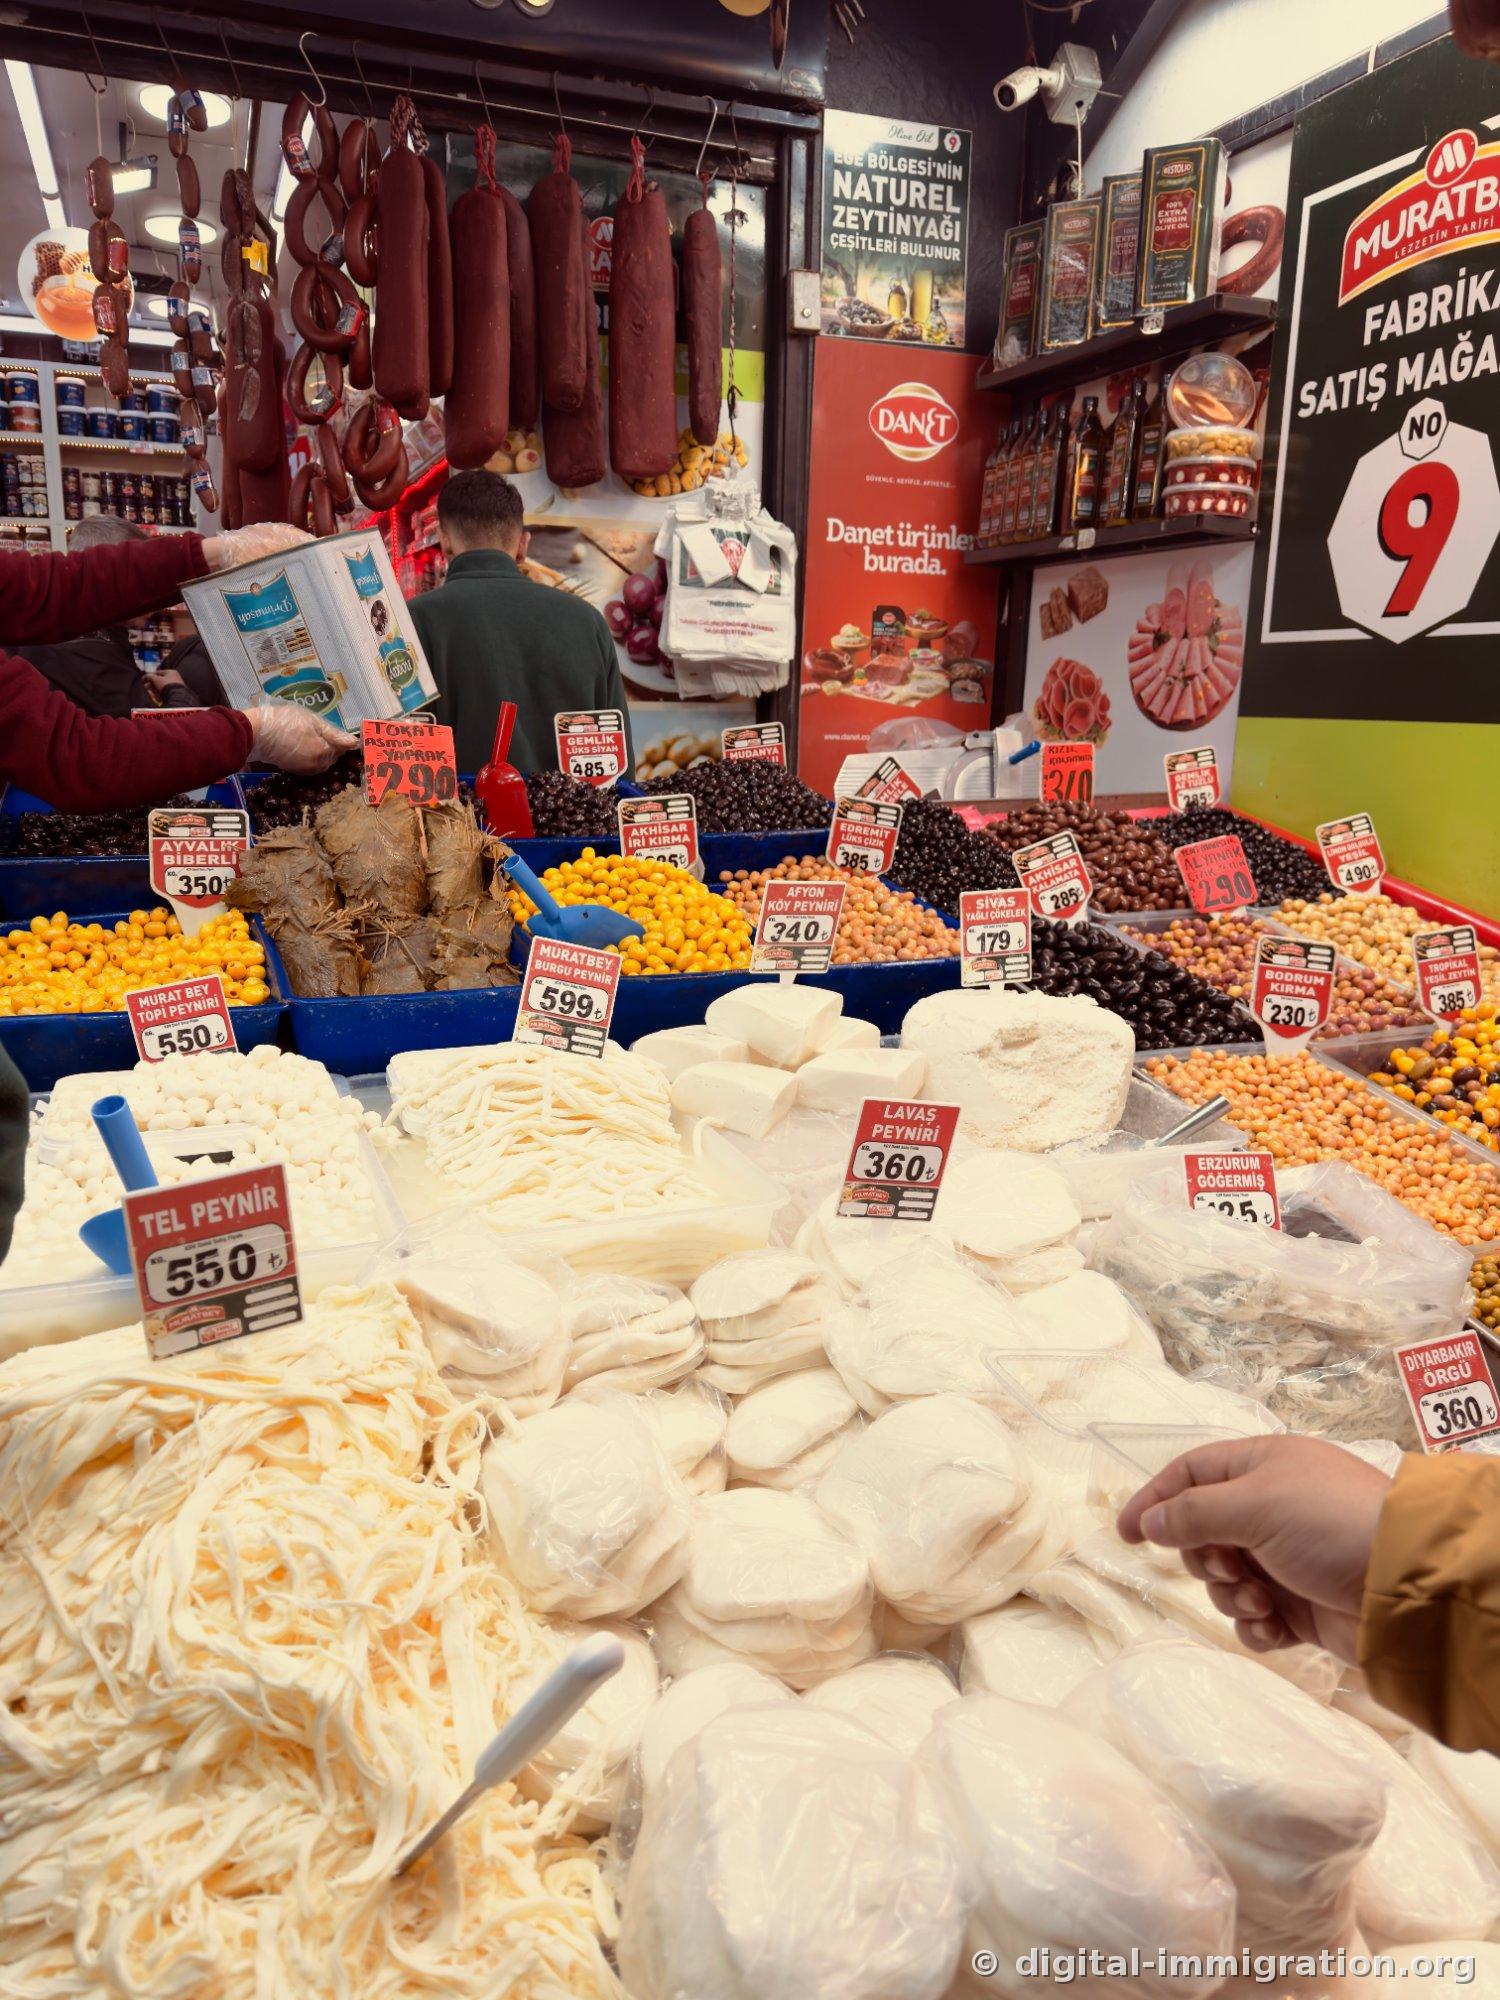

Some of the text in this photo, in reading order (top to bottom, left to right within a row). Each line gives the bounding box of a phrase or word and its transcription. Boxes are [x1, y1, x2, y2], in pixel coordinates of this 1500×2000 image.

[916, 129, 935, 144] Oil
[867, 151, 963, 182] BÖLGESİ'NİN
[832, 169, 961, 214] NATUREL
[832, 205, 961, 243] ZEYTİNYAĞI
[1158, 207, 1188, 218] EXTRA
[1158, 216, 1187, 225] VIRGIN
[1353, 176, 1500, 271] MURATB
[830, 232, 961, 262] ÇEŞİTLERİ BULUNUR
[1394, 216, 1494, 260] LEZZETİN TARİFİ
[1297, 329, 1500, 419] SATIŞ MAĞA
[878, 407, 952, 447] DANET
[1408, 411, 1442, 442] NO
[826, 517, 896, 549] Danet
[1377, 461, 1460, 618] 9
[863, 545, 948, 576] burada.
[367, 721, 440, 738] TOKAT
[567, 734, 616, 746] GEMLİK
[382, 749, 447, 764] YAPRAK
[566, 744, 619, 755] LÜKS SİYAH
[729, 746, 780, 760] MUDANYA
[573, 761, 605, 778] 485
[628, 834, 691, 848] İRİ KIRMA
[630, 822, 688, 837] AKHİSAR
[839, 822, 892, 840] EDREMİT
[841, 833, 886, 848] LÜKS ÇİZİK
[160, 840, 240, 852] AYVALIK
[163, 851, 237, 865] BİBERLİ
[840, 851, 869, 871] 385
[1028, 857, 1079, 886] AKHİSAR
[1030, 869, 1081, 895] KALAMATA
[1345, 864, 1371, 883] 490
[178, 875, 222, 899] 350
[786, 886, 826, 898] AFYON
[1050, 887, 1080, 910] 285
[1198, 871, 1253, 908] 290
[767, 898, 839, 912] KÖY PEYNİRİ
[975, 895, 1016, 910] SİVAS
[965, 907, 1027, 922] YAĞLI ÇÖKELEK
[770, 920, 820, 942] 340
[976, 929, 1011, 955] 179
[538, 943, 614, 971] MURATBEY
[1428, 957, 1468, 973] TROPİKAL
[534, 960, 573, 976] BURGU
[572, 966, 613, 986] PEYNİR
[1264, 969, 1325, 987] BODRUM
[1424, 967, 1476, 985] YEŞİL ZEYTİN
[138, 983, 210, 1009] MURAT BEY
[1270, 982, 1316, 997] KIRMA
[136, 1006, 167, 1024] TOPİ
[168, 993, 220, 1017] PEYNİRİ
[539, 985, 594, 1019] 599
[1437, 990, 1465, 1013] 385
[1270, 1004, 1306, 1027] 230
[158, 1024, 211, 1057] 550
[883, 1104, 937, 1126] LAVAŞ
[871, 1123, 941, 1143] PEYNİRİ
[863, 1150, 926, 1182] 360
[1197, 1156, 1261, 1171] ERZURUM
[1196, 1171, 1266, 1191] GÖĞERMİŞ
[138, 1183, 280, 1239] TEL PEYNİR
[166, 1243, 258, 1298] 550
[1404, 1340, 1478, 1373] DİYARBAKIR
[1423, 1358, 1473, 1388] ÖRGÜ
[1433, 1395, 1484, 1436] 360
